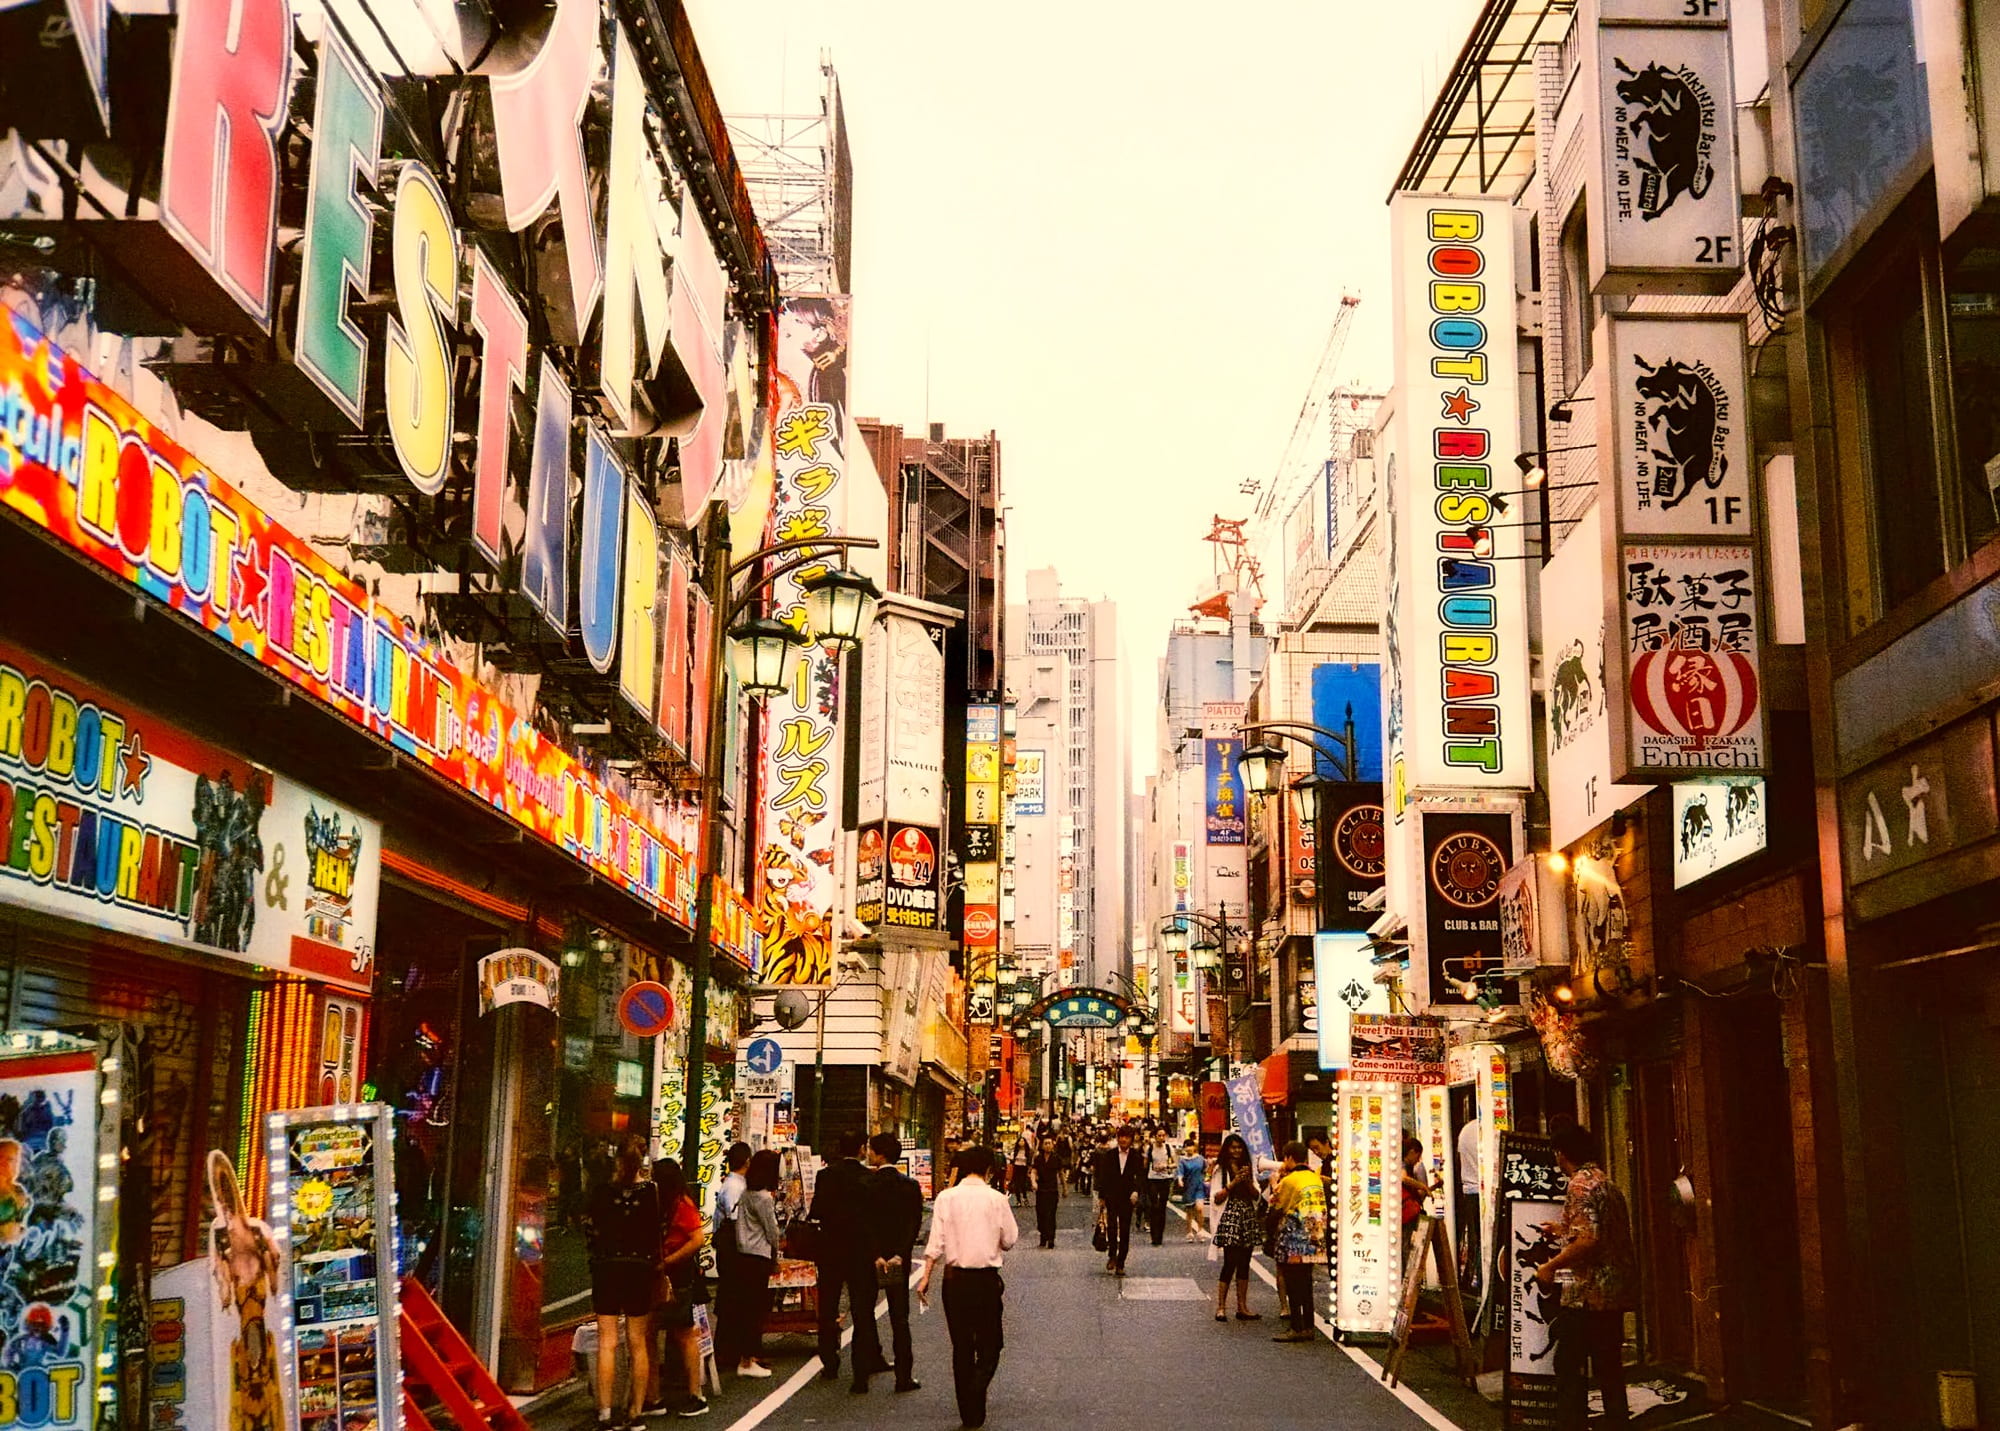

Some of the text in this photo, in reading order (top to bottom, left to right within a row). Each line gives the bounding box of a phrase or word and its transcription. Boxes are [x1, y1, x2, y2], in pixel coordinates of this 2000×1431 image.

[1615, 106, 1627, 123] NO
[1676, 63, 1717, 159] YAKINIKU Bar
[1617, 169, 1631, 186] NO
[1695, 235, 1732, 263] 2F
[1427, 208, 1489, 386] ROBOT
[1634, 401, 1646, 417] NO
[1693, 359, 1730, 456] YAKINIKU Bar
[1637, 461, 1649, 477] NO
[1658, 468, 1675, 495] 2nd
[77, 402, 240, 619] ROBOT
[1704, 496, 1742, 525] 1F
[1626, 562, 1753, 612] 駄菓子
[1433, 427, 1504, 774] RESTAURANT
[930, 627, 942, 642] 2F
[1631, 612, 1754, 654] 居酒屋
[267, 544, 454, 760] RESTAURANT
[1668, 654, 1719, 731] 縁日
[1207, 706, 1241, 716] PIATTO
[0, 663, 126, 803] ROBOT
[1643, 735, 1757, 746] DAGASHI IZAKAYA
[1641, 746, 1762, 768] Ennichi
[314, 847, 351, 899] REN
[1442, 879, 1498, 904] TOKYO
[887, 907, 936, 927] 受付B1F
[1444, 919, 1468, 931] CLUB
[1479, 920, 1499, 931] BAR
[1354, 1026, 1381, 1035] Here!
[1384, 1027, 1404, 1036] This
[1407, 1028, 1414, 1036] is
[1354, 1072, 1418, 1083] BUY THE TICKETS
[1514, 1269, 1522, 1283] NO
[1513, 1319, 1522, 1333] NO
